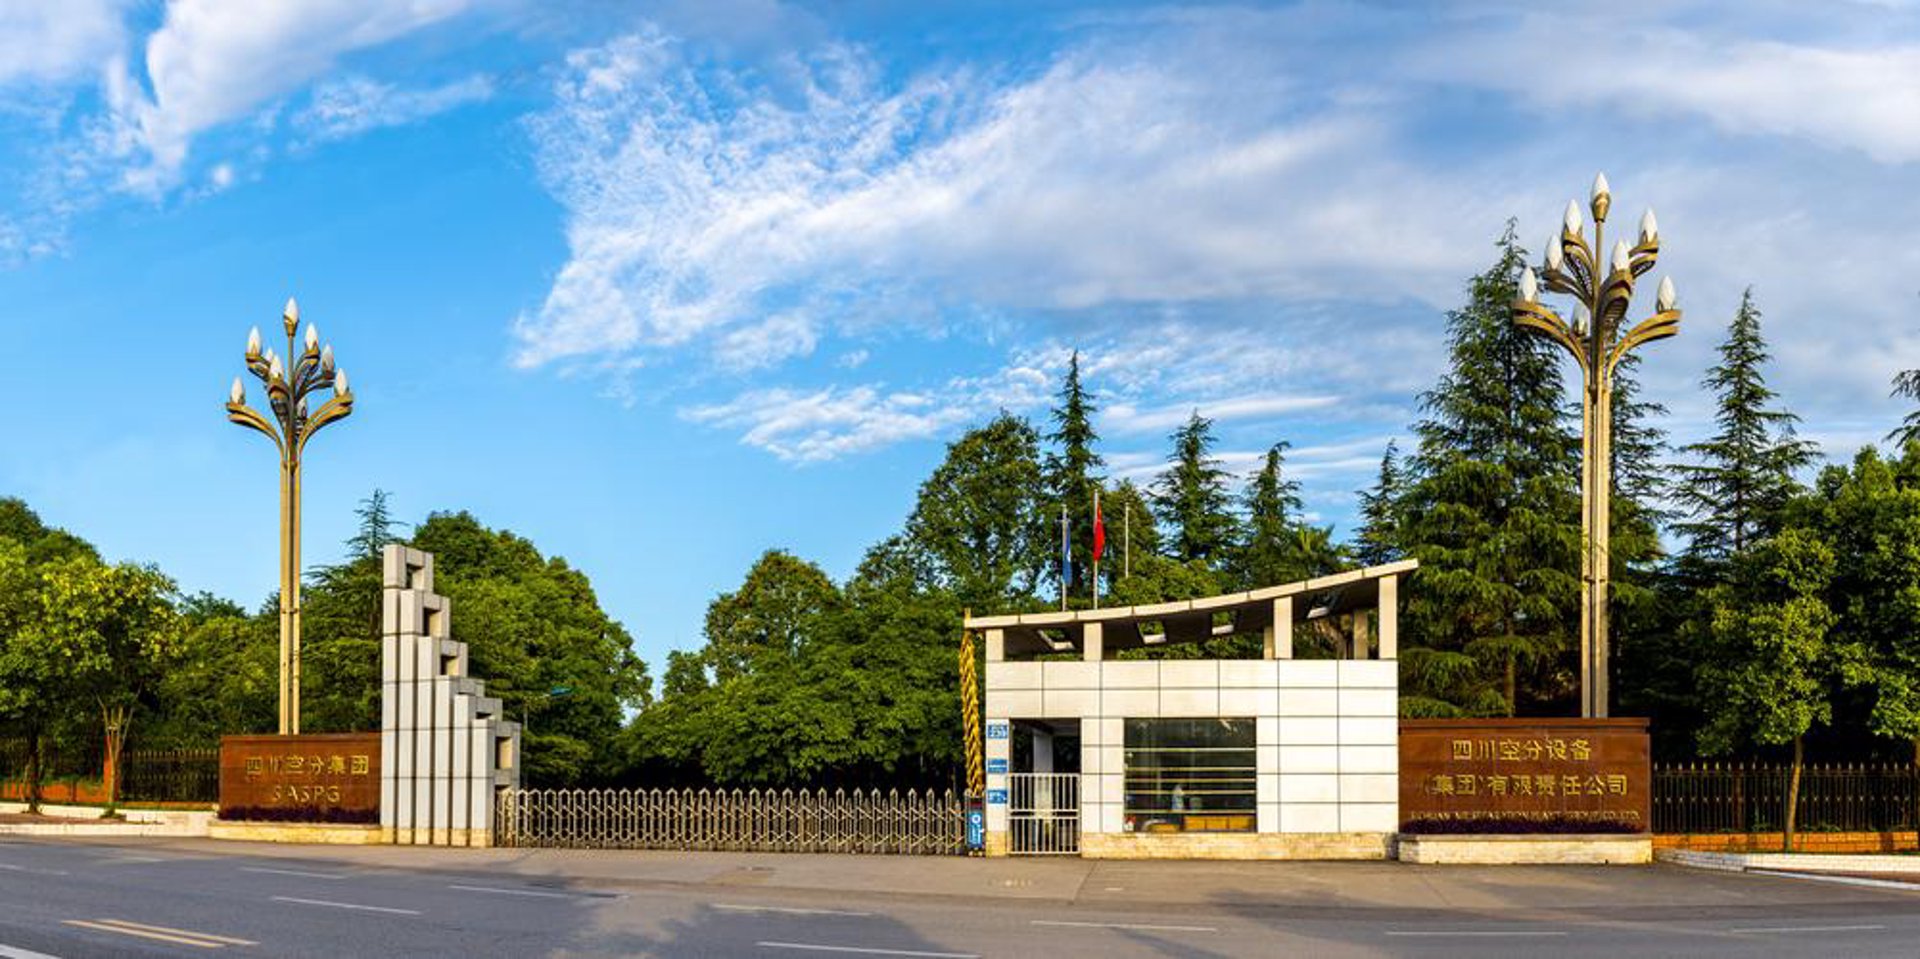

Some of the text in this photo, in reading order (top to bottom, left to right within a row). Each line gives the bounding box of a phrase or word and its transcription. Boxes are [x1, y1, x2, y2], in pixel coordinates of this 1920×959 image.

[1452, 738, 1592, 761] 四川空分设备
[246, 754, 369, 776] 四川空分集团
[272, 785, 341, 803] SASPG
